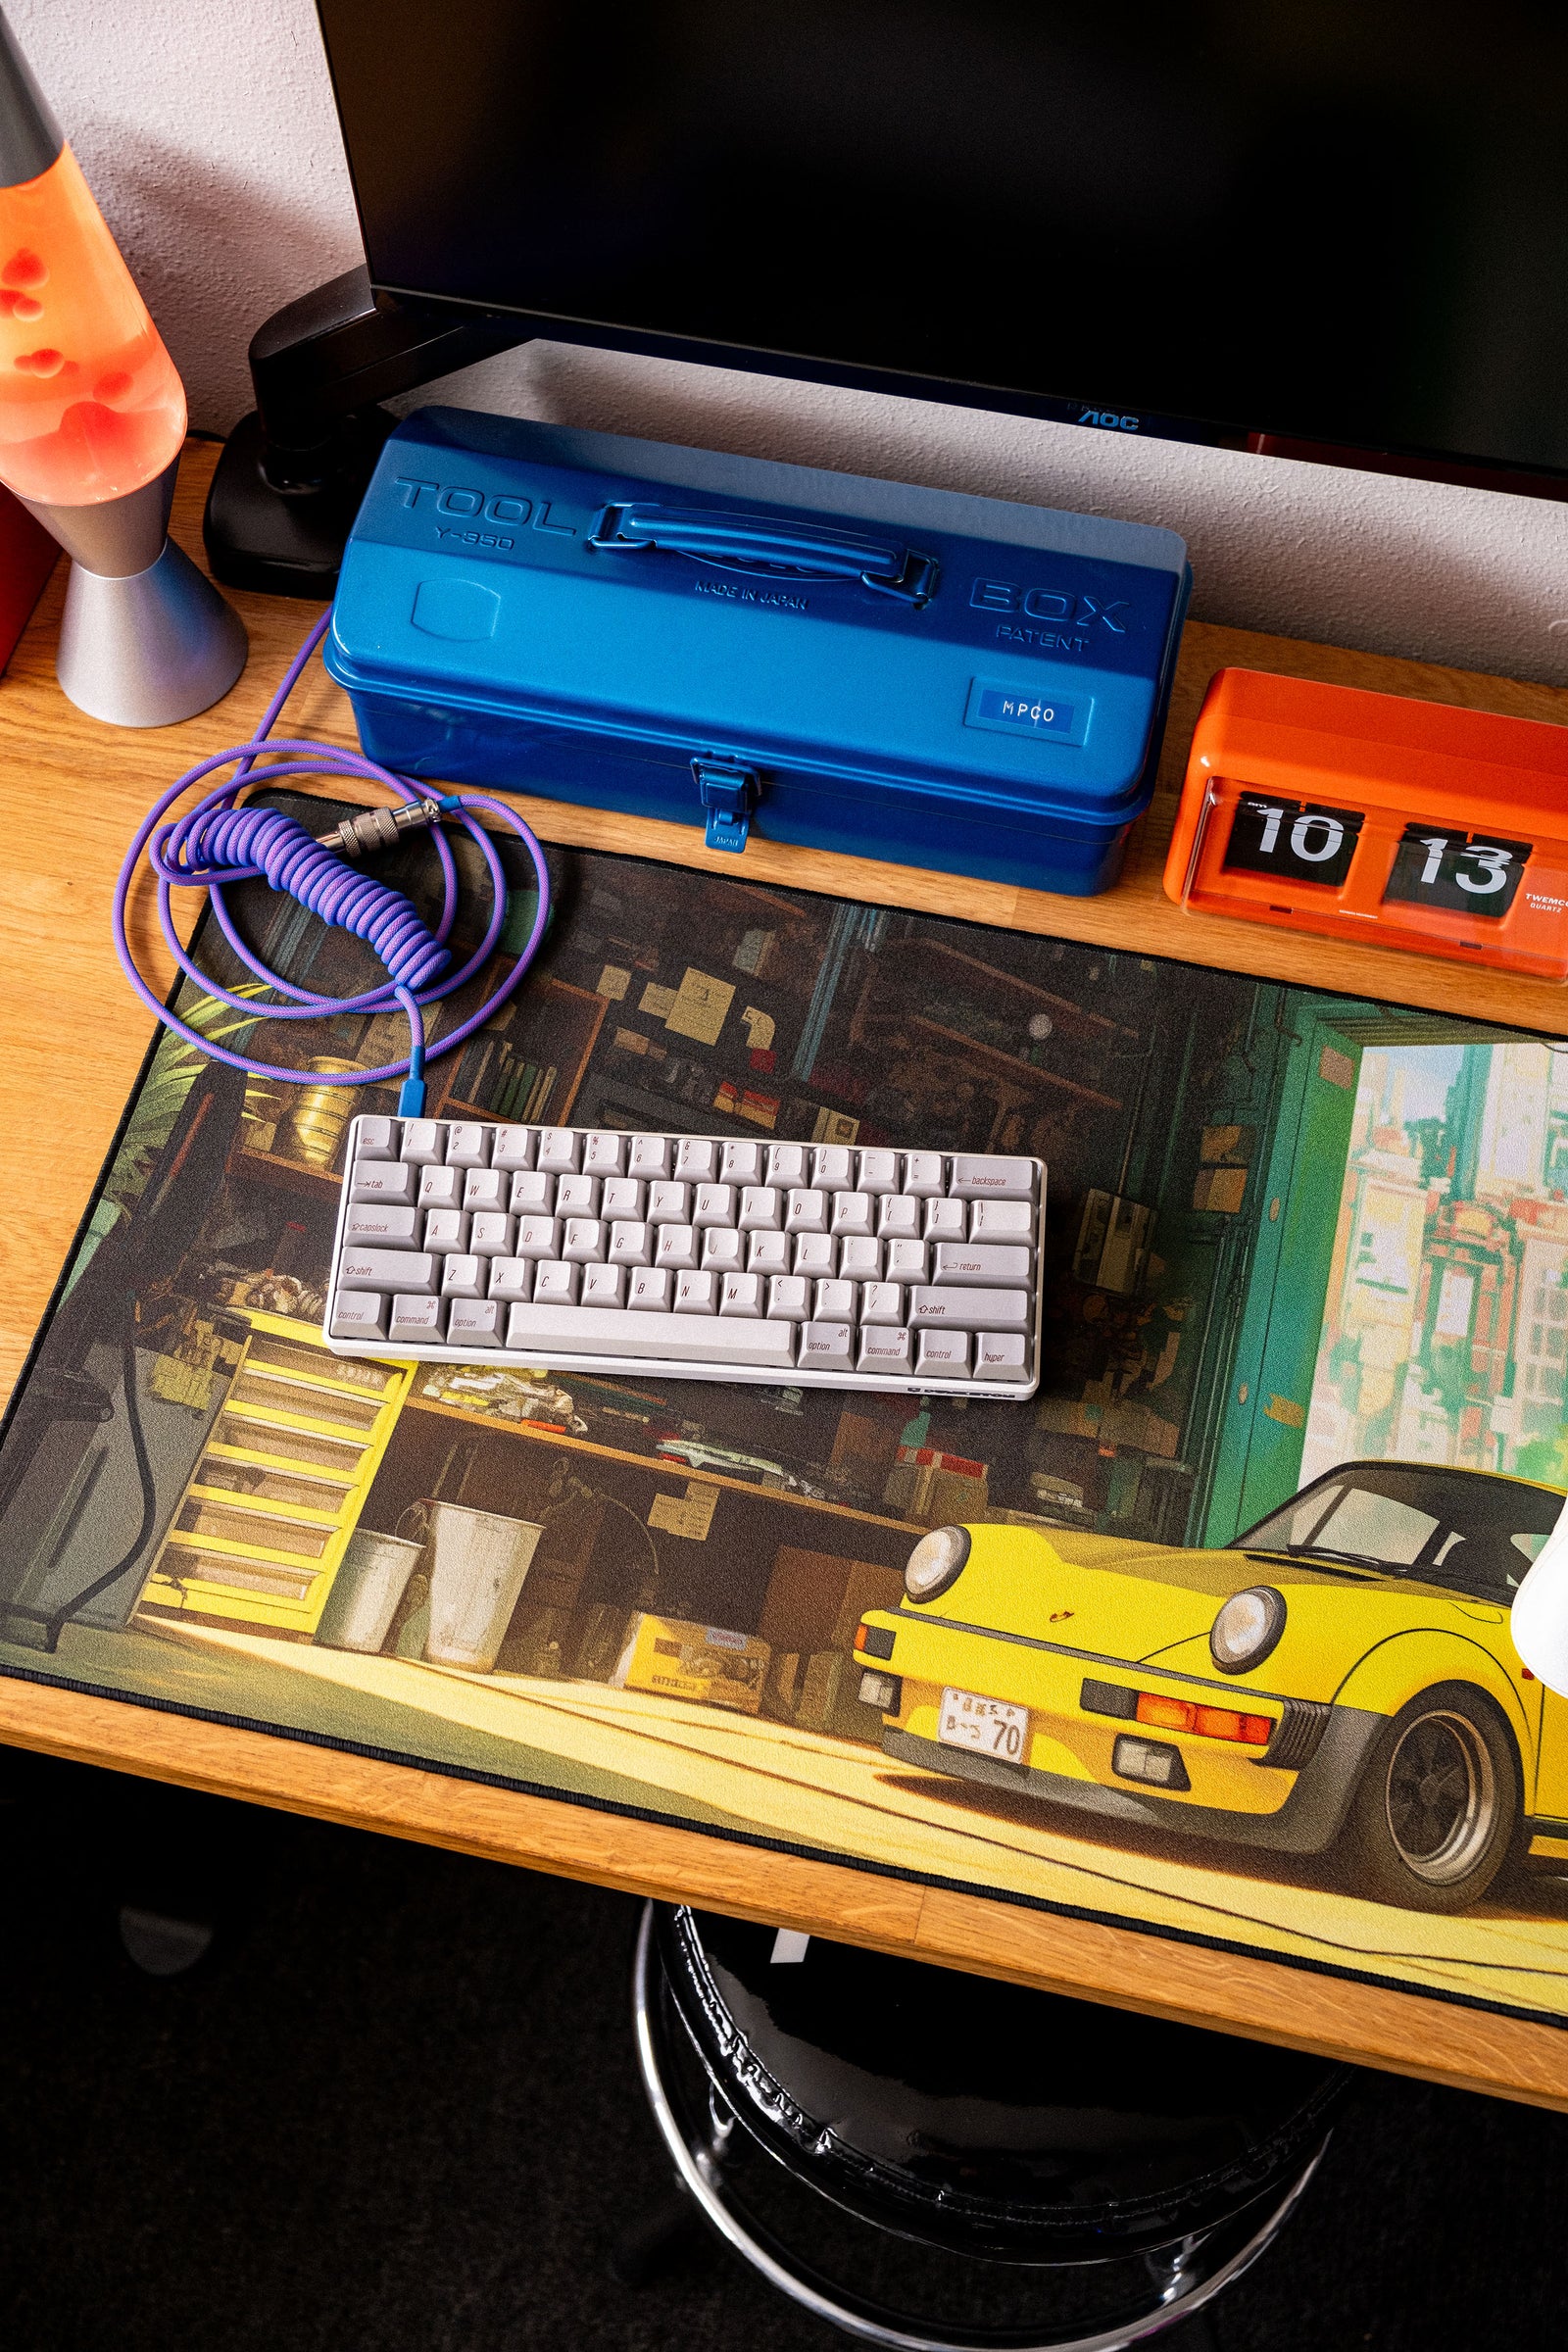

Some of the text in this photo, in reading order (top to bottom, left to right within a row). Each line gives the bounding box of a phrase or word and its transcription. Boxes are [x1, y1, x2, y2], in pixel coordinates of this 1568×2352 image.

[1079, 411, 1139, 430] AOC
[435, 526, 515, 551] Y-350
[395, 476, 1129, 633] TOOL BOX
[695, 580, 809, 611] MADE IN JAPAN
[996, 624, 1090, 652] PATENT
[1003, 700, 1054, 722] MPCO
[1256, 808, 1514, 894] 10 13
[1530, 902, 1562, 913] QUARTZ
[363, 1137, 374, 1146] esc
[371, 1180, 383, 1189] tab
[972, 1176, 1005, 1186] backspace
[425, 1182, 432, 1193] Q
[470, 1186, 479, 1196] W
[516, 1187, 523, 1198] E
[564, 1190, 570, 1200] R
[610, 1194, 615, 1203] T
[657, 1197, 663, 1207] Y
[702, 1200, 710, 1210] U
[748, 1201, 752, 1212] I
[795, 1203, 802, 1214] O
[841, 1207, 848, 1218] P
[360, 1223, 389, 1233] capslock
[431, 1225, 438, 1235] A
[477, 1228, 485, 1239] S
[525, 1232, 532, 1242] D
[571, 1234, 578, 1245] F
[616, 1238, 624, 1248] G
[664, 1241, 672, 1250] H
[757, 1247, 764, 1256] K
[803, 1250, 808, 1259] L
[355, 1267, 372, 1276] shift
[449, 1270, 456, 1280] Z
[496, 1273, 504, 1283] X
[541, 1276, 549, 1287] C
[590, 1279, 597, 1289] V
[638, 1283, 645, 1294] B
[682, 1286, 690, 1297] N
[728, 1289, 737, 1298] M
[485, 1304, 496, 1314] alt
[928, 1304, 946, 1315] shift
[338, 1310, 364, 1320] control
[396, 1315, 429, 1325] command
[454, 1319, 477, 1328] option
[838, 1328, 848, 1337] alt
[867, 1348, 901, 1356] command
[984, 1353, 1004, 1362] hyper
[993, 1719, 1020, 1755] 70
